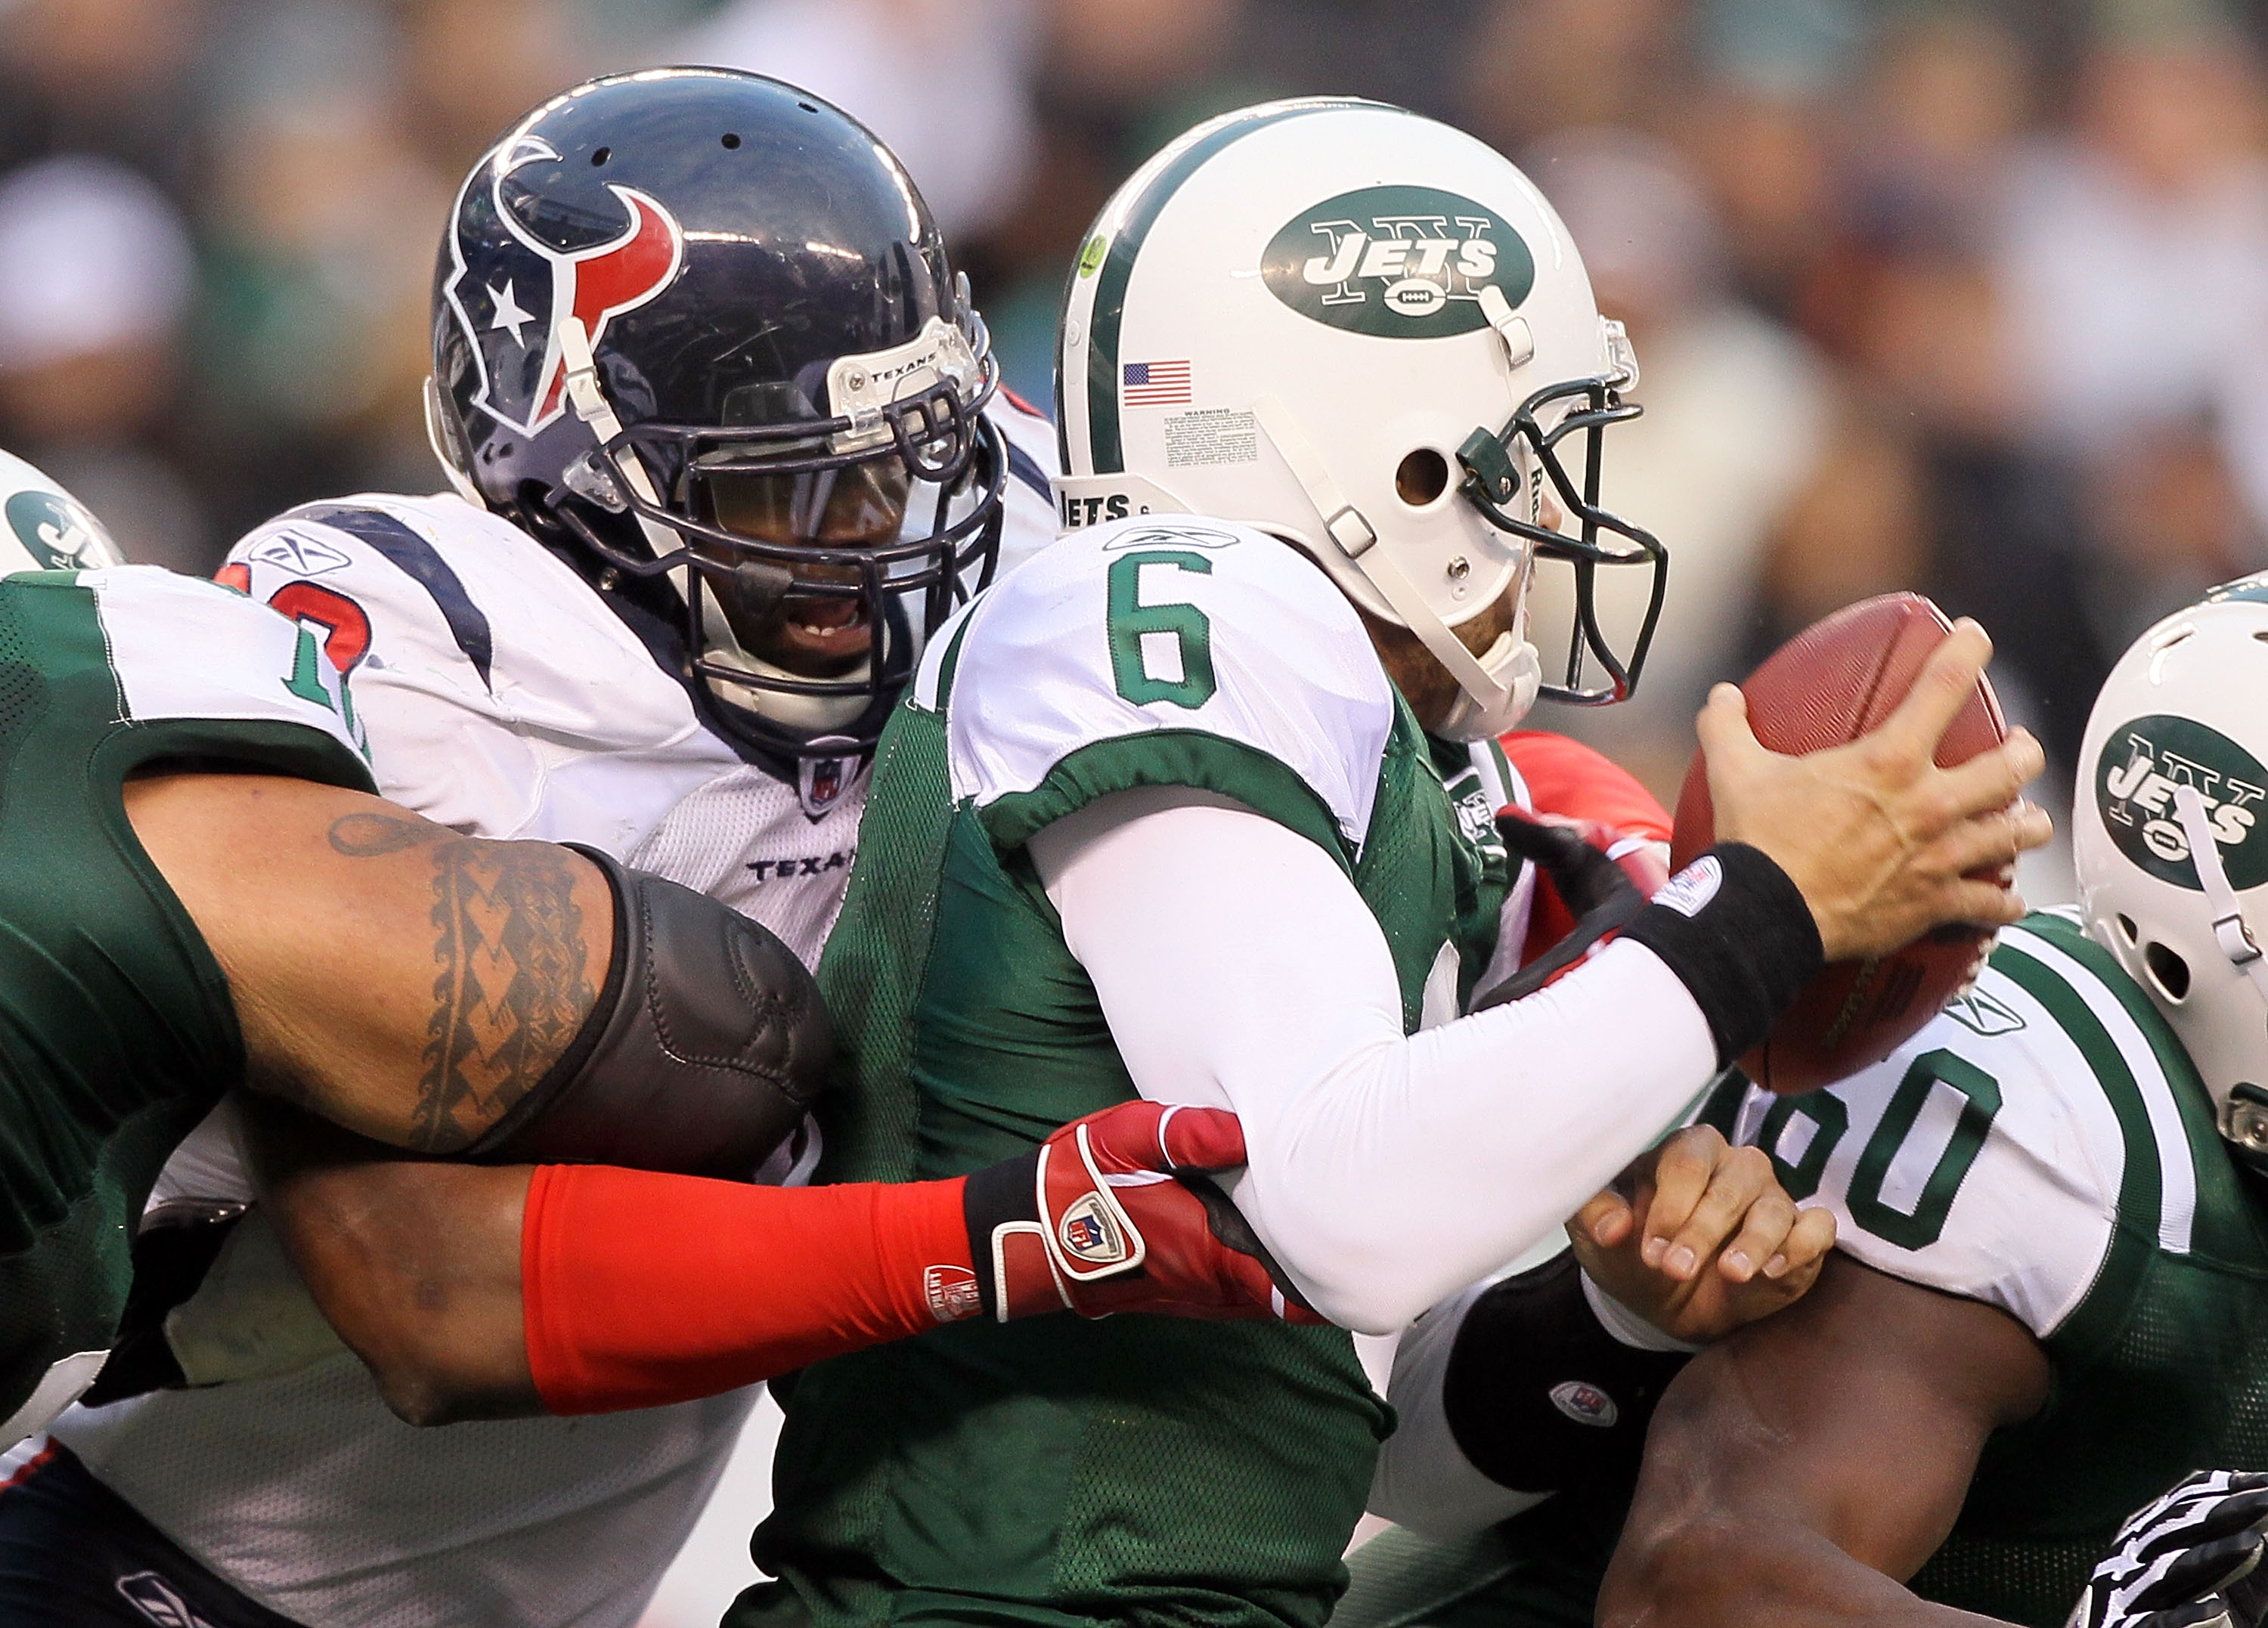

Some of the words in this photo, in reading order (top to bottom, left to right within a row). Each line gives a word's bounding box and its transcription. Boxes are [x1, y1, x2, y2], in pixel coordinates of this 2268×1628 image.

[1303, 232, 1498, 285] JETS
[872, 351, 937, 382] TEXANS
[1184, 408, 1230, 416] WARNING
[1061, 491, 1129, 528] ETS
[1107, 550, 1217, 710] 6
[745, 847, 856, 881] TEXA
